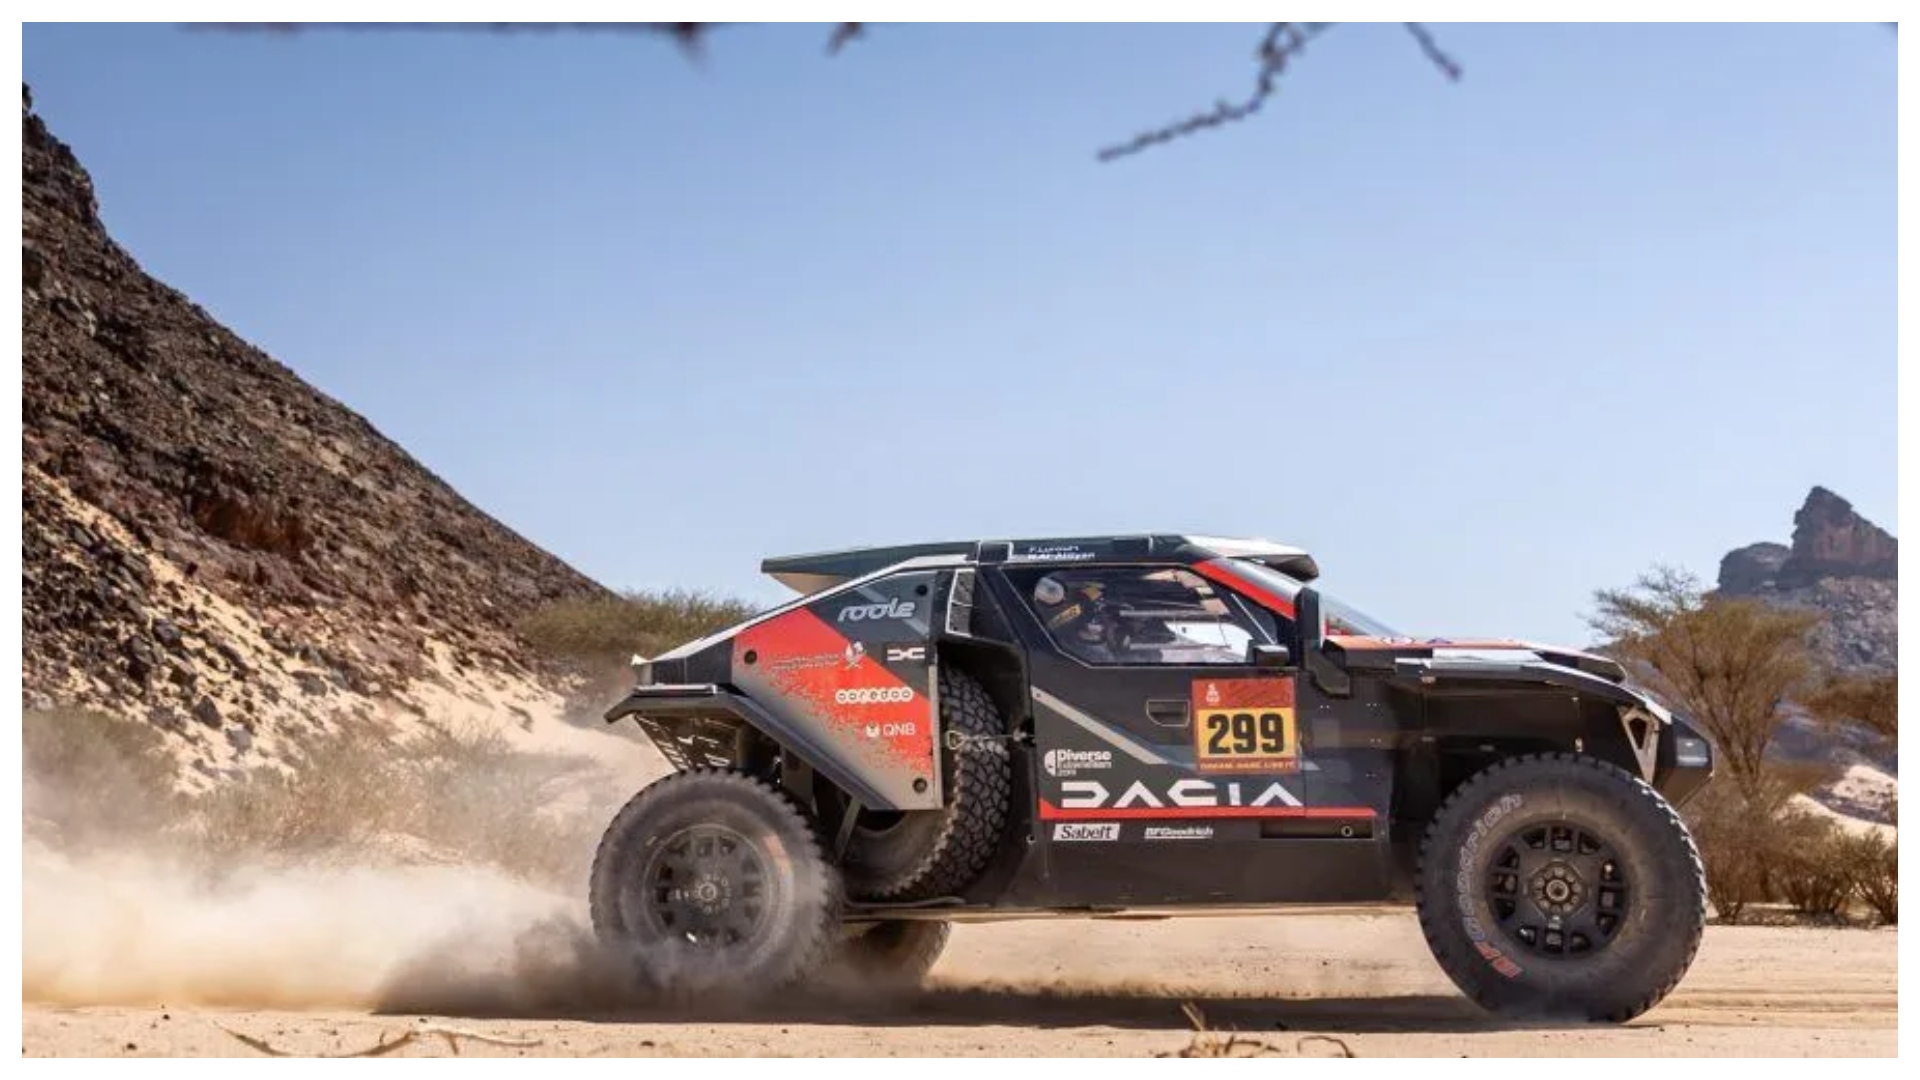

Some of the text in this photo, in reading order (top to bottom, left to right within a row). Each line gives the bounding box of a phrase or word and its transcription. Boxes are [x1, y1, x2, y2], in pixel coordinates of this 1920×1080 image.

[837, 597, 916, 622] roole
[835, 686, 915, 705] ooredoo
[882, 723, 916, 737] QNB
[1207, 713, 1284, 754] 299
[1057, 748, 1112, 762] Diverse
[1061, 780, 1303, 808] DACIA
[1060, 825, 1114, 840] Sabelt
